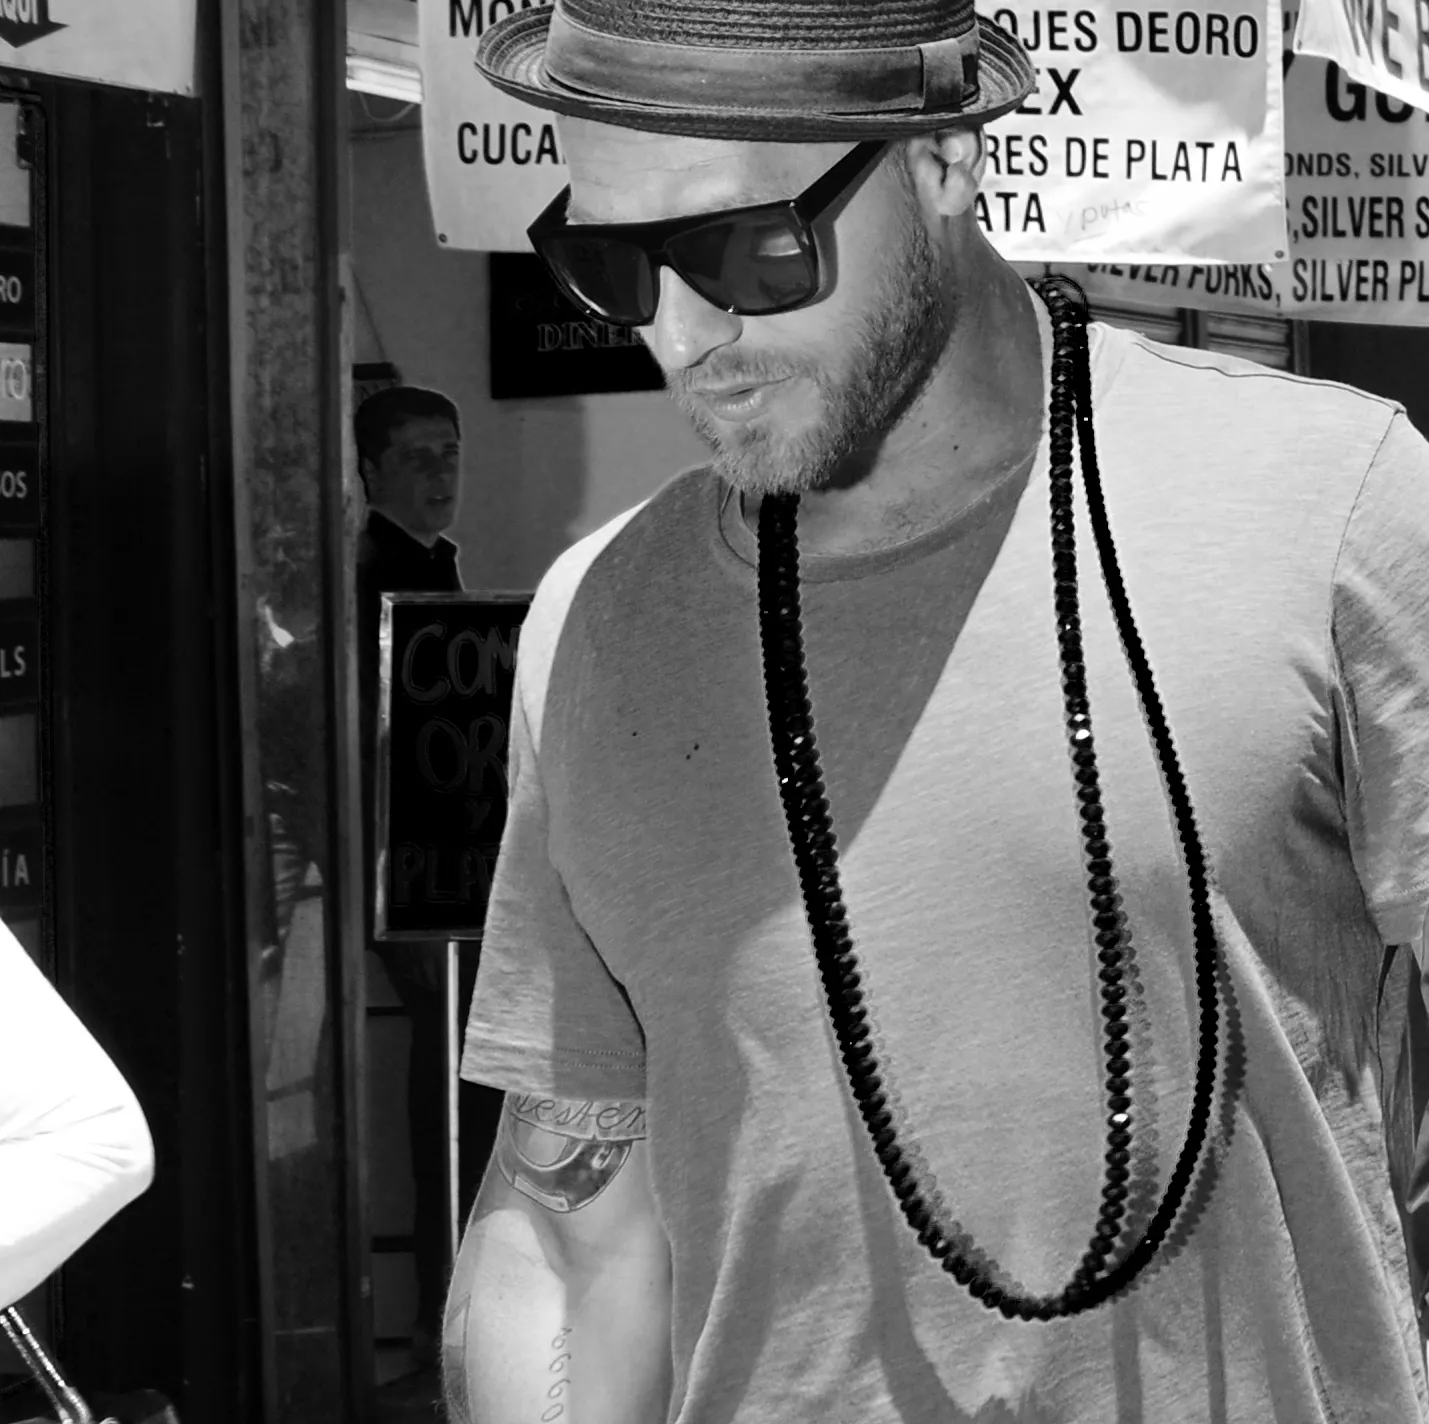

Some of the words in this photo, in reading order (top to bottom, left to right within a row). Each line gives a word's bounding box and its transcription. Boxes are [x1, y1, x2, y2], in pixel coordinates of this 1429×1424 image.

[457, 122, 567, 165] CUCA
[1066, 137, 1109, 179] DE
[1126, 139, 1243, 183] PLATA
[1292, 258, 1389, 303] SILVER
